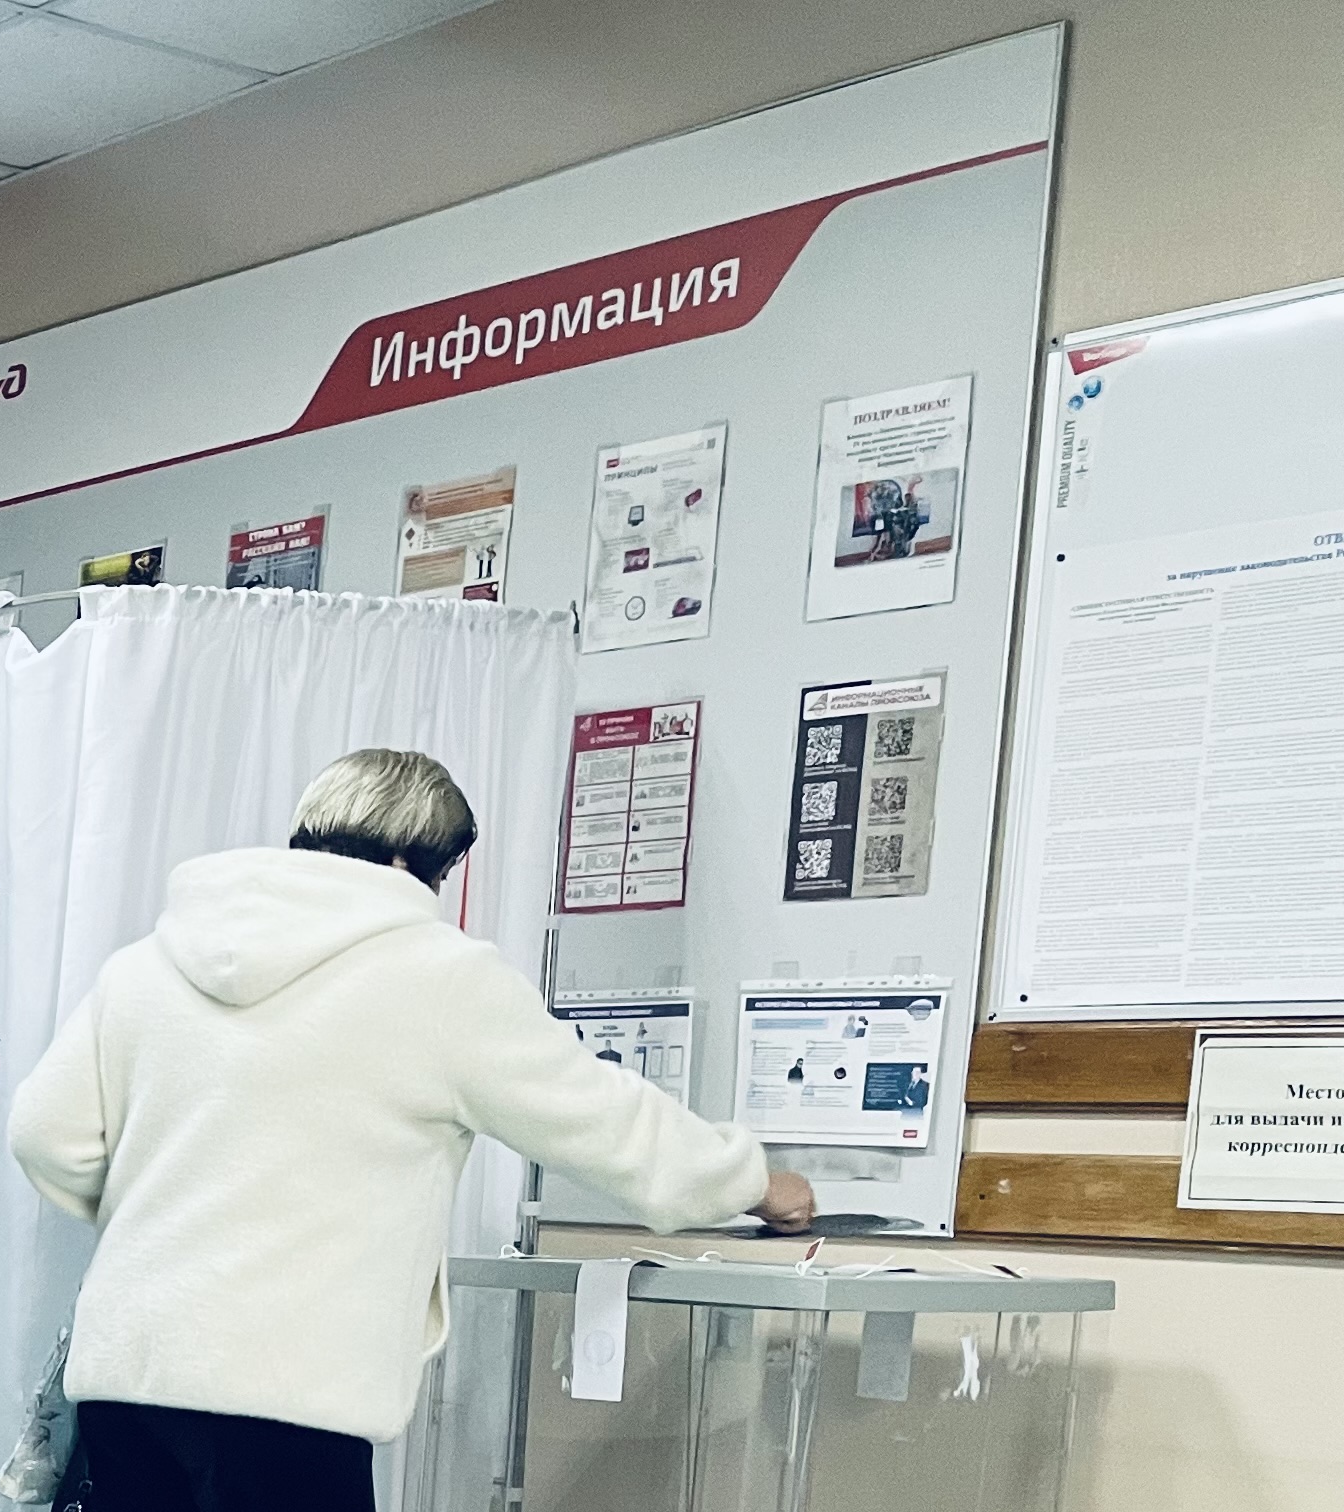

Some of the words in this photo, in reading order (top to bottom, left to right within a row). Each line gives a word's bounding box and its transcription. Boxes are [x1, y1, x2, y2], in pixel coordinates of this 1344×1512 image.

[369, 257, 741, 387] Информация
[1210, 1114, 1244, 1126] для
[1250, 1115, 1324, 1126] выдачи
